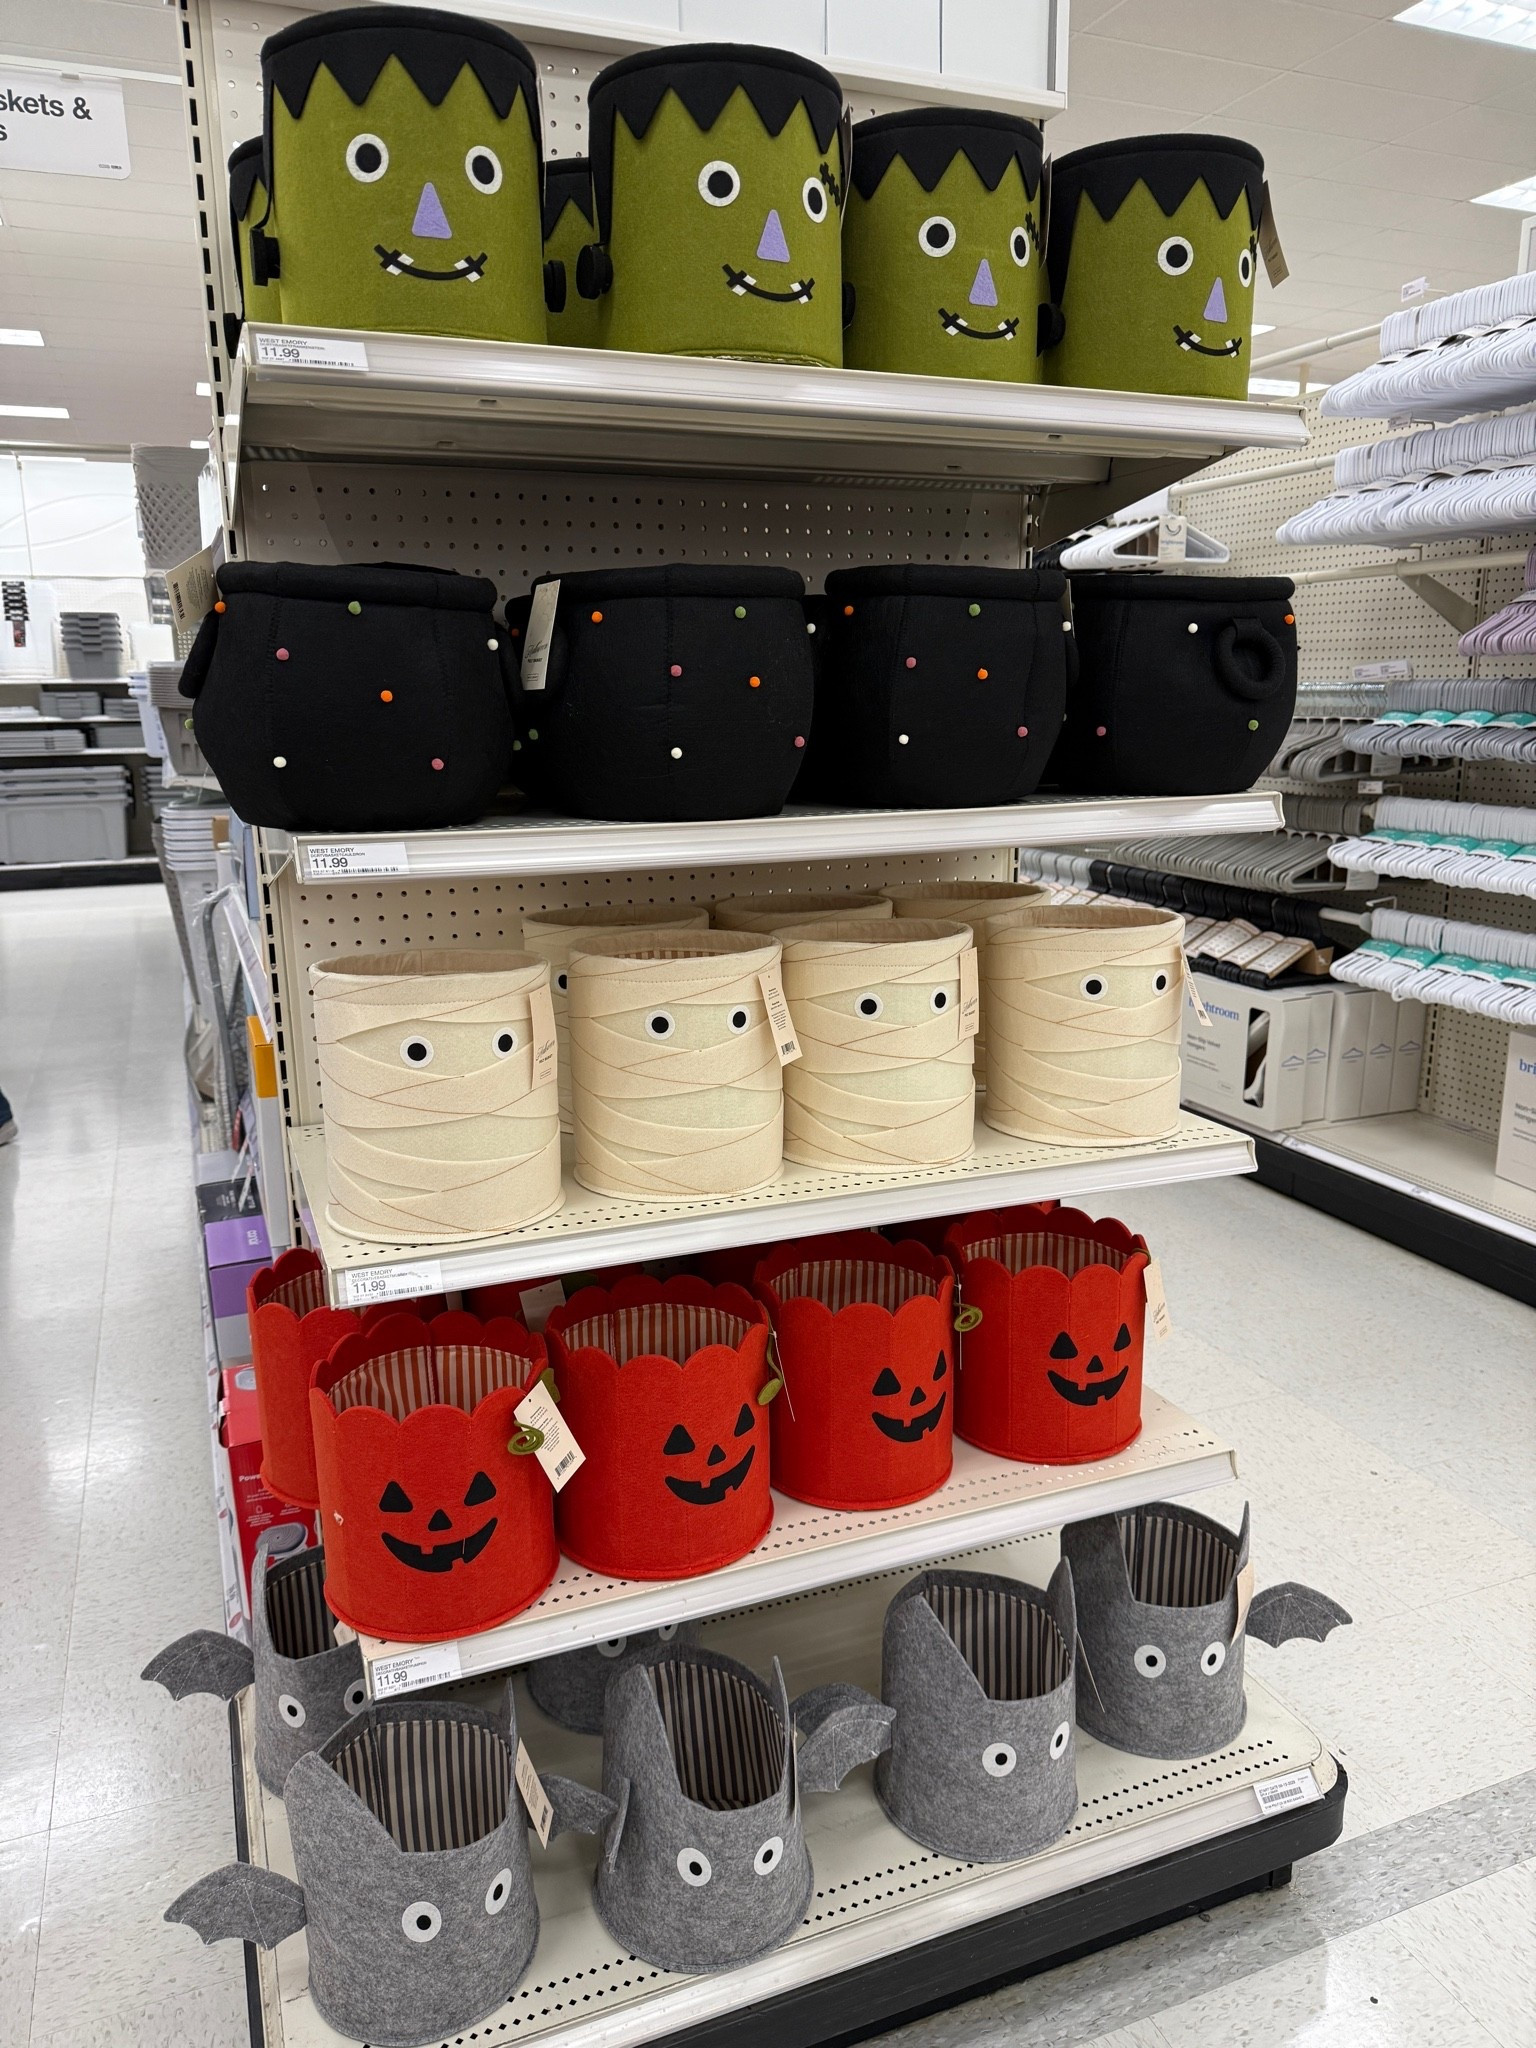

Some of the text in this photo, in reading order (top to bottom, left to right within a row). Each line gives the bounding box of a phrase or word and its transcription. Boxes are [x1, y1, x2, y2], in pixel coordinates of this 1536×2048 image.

[72, 97, 93, 120] &
[259, 337, 280, 345] WEST
[261, 346, 300, 359] 11.99
[312, 857, 348, 869] 11.99
[351, 1268, 393, 1279] WEST EMORY
[353, 1280, 386, 1294] 11.99
[375, 1657, 414, 1672] WEST EMORY
[377, 1670, 408, 1687] 11.99
